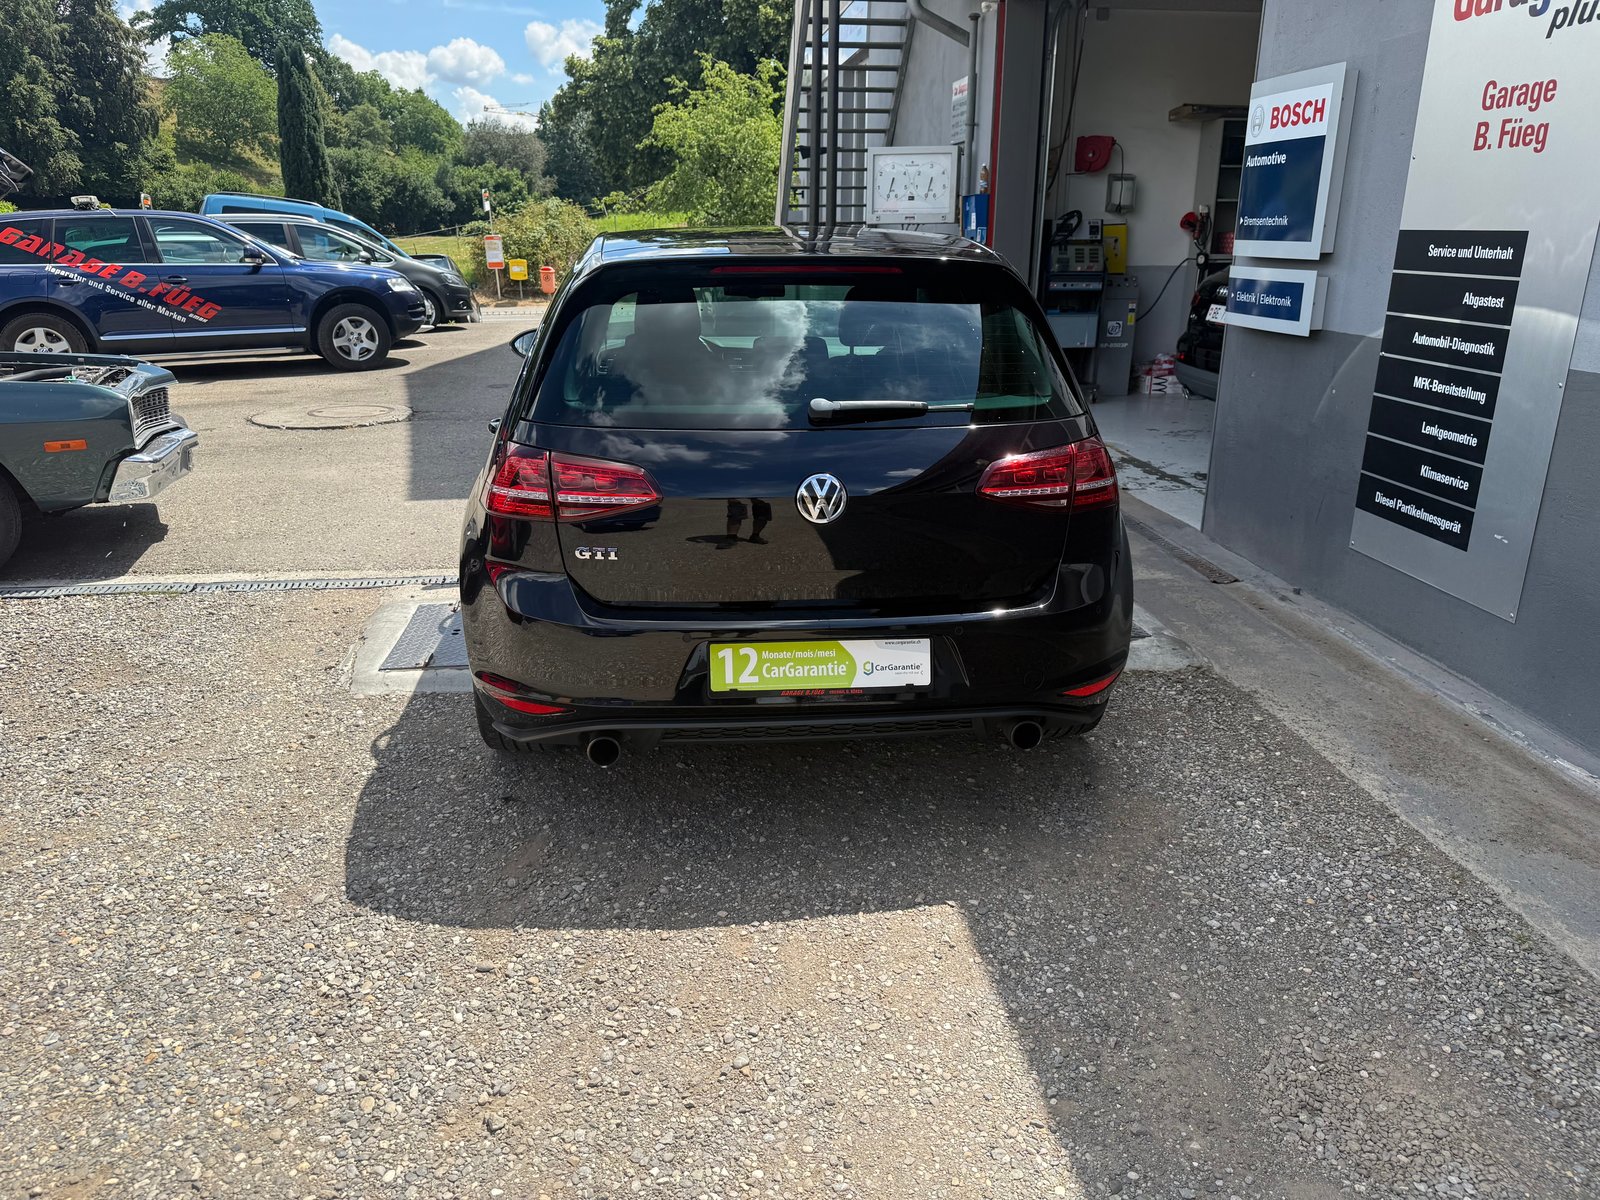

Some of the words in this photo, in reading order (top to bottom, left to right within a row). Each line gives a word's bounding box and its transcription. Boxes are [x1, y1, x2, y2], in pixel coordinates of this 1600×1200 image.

[1545, 0, 1600, 39] plu
[1481, 79, 1557, 112] Garage
[1269, 98, 1326, 129] BOSCH
[1473, 121, 1492, 151] B.
[1497, 118, 1549, 153] Füeg
[1246, 151, 1287, 167] Automotive
[1243, 215, 1289, 226] Bremsentechnik
[0, 227, 123, 279] GARAGE
[1428, 244, 1456, 258] Service
[1458, 246, 1473, 258] und
[1474, 246, 1513, 260] Unterhalt
[45, 264, 87, 284] Reparatur
[88, 280, 104, 290] und
[105, 285, 136, 303] Service
[136, 299, 157, 311] aller
[157, 305, 187, 323] Marken
[1236, 291, 1256, 304] Elektrik
[1260, 294, 1292, 307] Elektronik
[1462, 292, 1504, 309] Abgastest
[1412, 332, 1495, 356] Automobil-Diagnostik
[1413, 376, 1487, 405] MFK-Bereitstellung
[1421, 421, 1478, 447] Lenkgeometrie
[1420, 464, 1470, 491] Klimaservice
[1375, 491, 1397, 510] Diesel
[1396, 500, 1462, 534] Partikelmessgerät
[574, 546, 618, 560] GTI
[717, 647, 759, 684] 12
[762, 661, 847, 678] CarGarantie
[874, 662, 921, 672] CarGarantie
